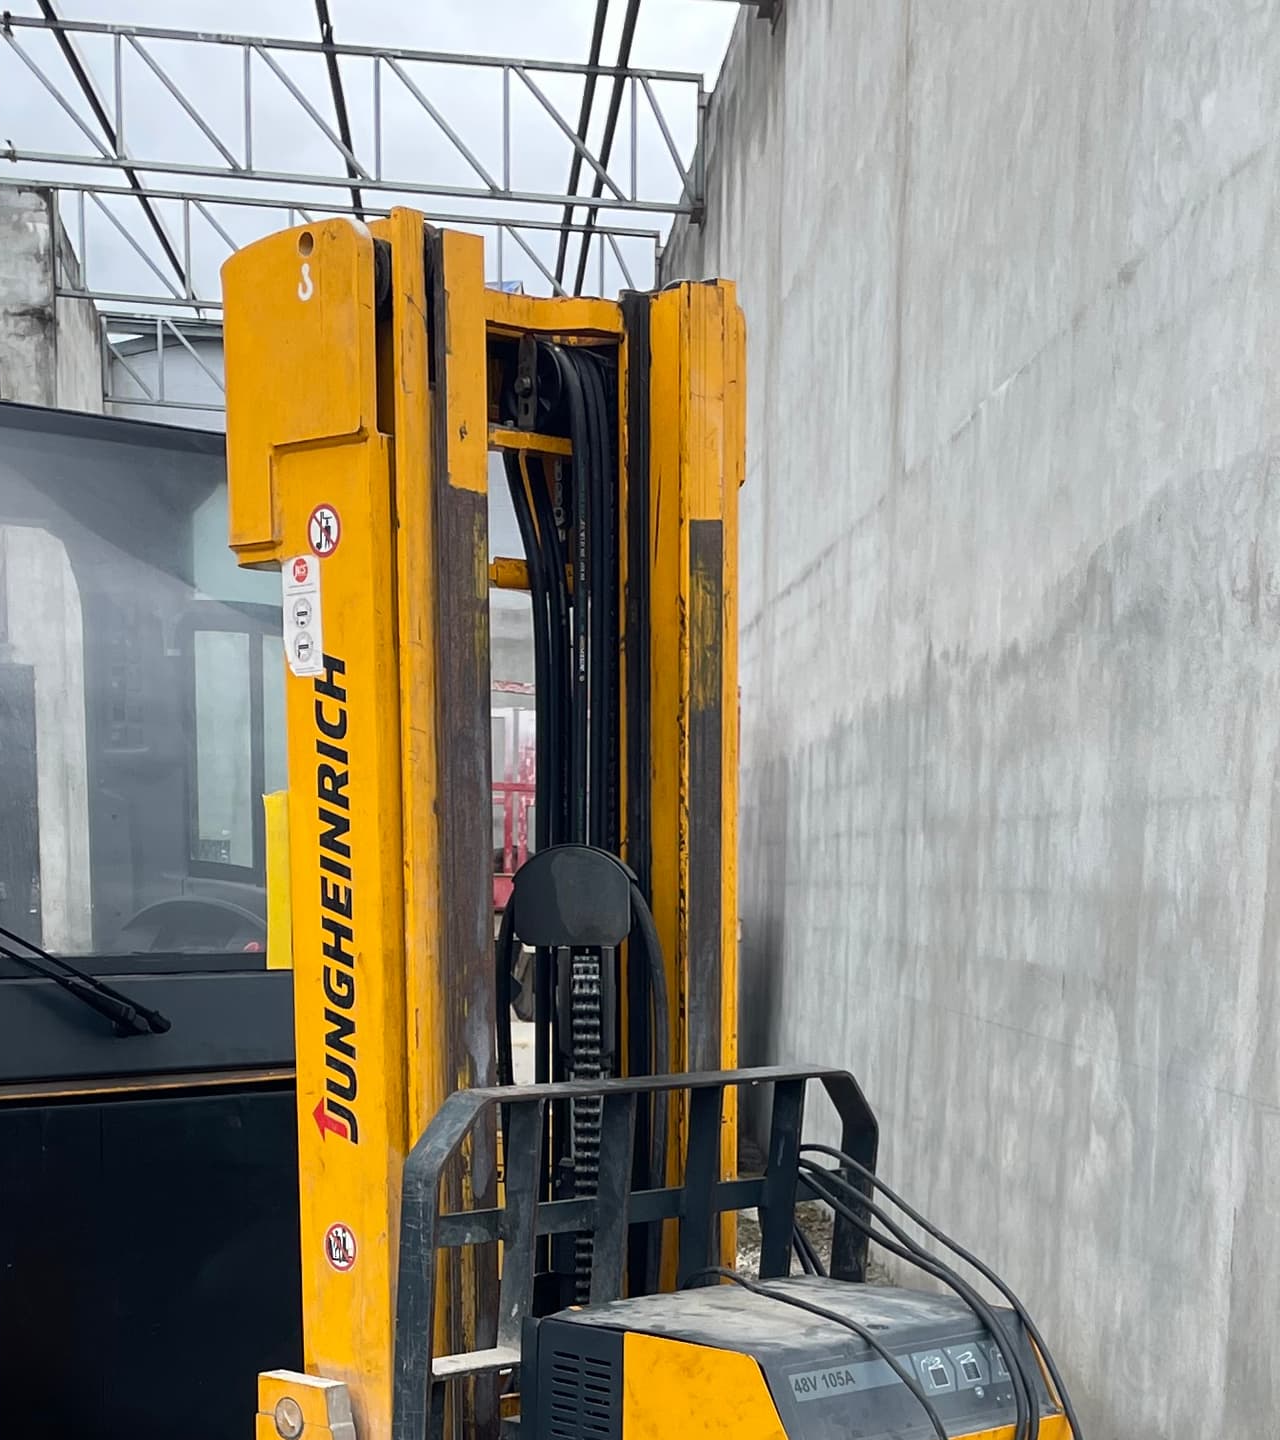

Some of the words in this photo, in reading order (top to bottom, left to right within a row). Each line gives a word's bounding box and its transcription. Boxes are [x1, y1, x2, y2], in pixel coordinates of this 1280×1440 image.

[312, 653, 359, 1145] JUNGHEINRICH
[794, 1375, 818, 1394] 48V
[821, 1370, 856, 1389] 105A
